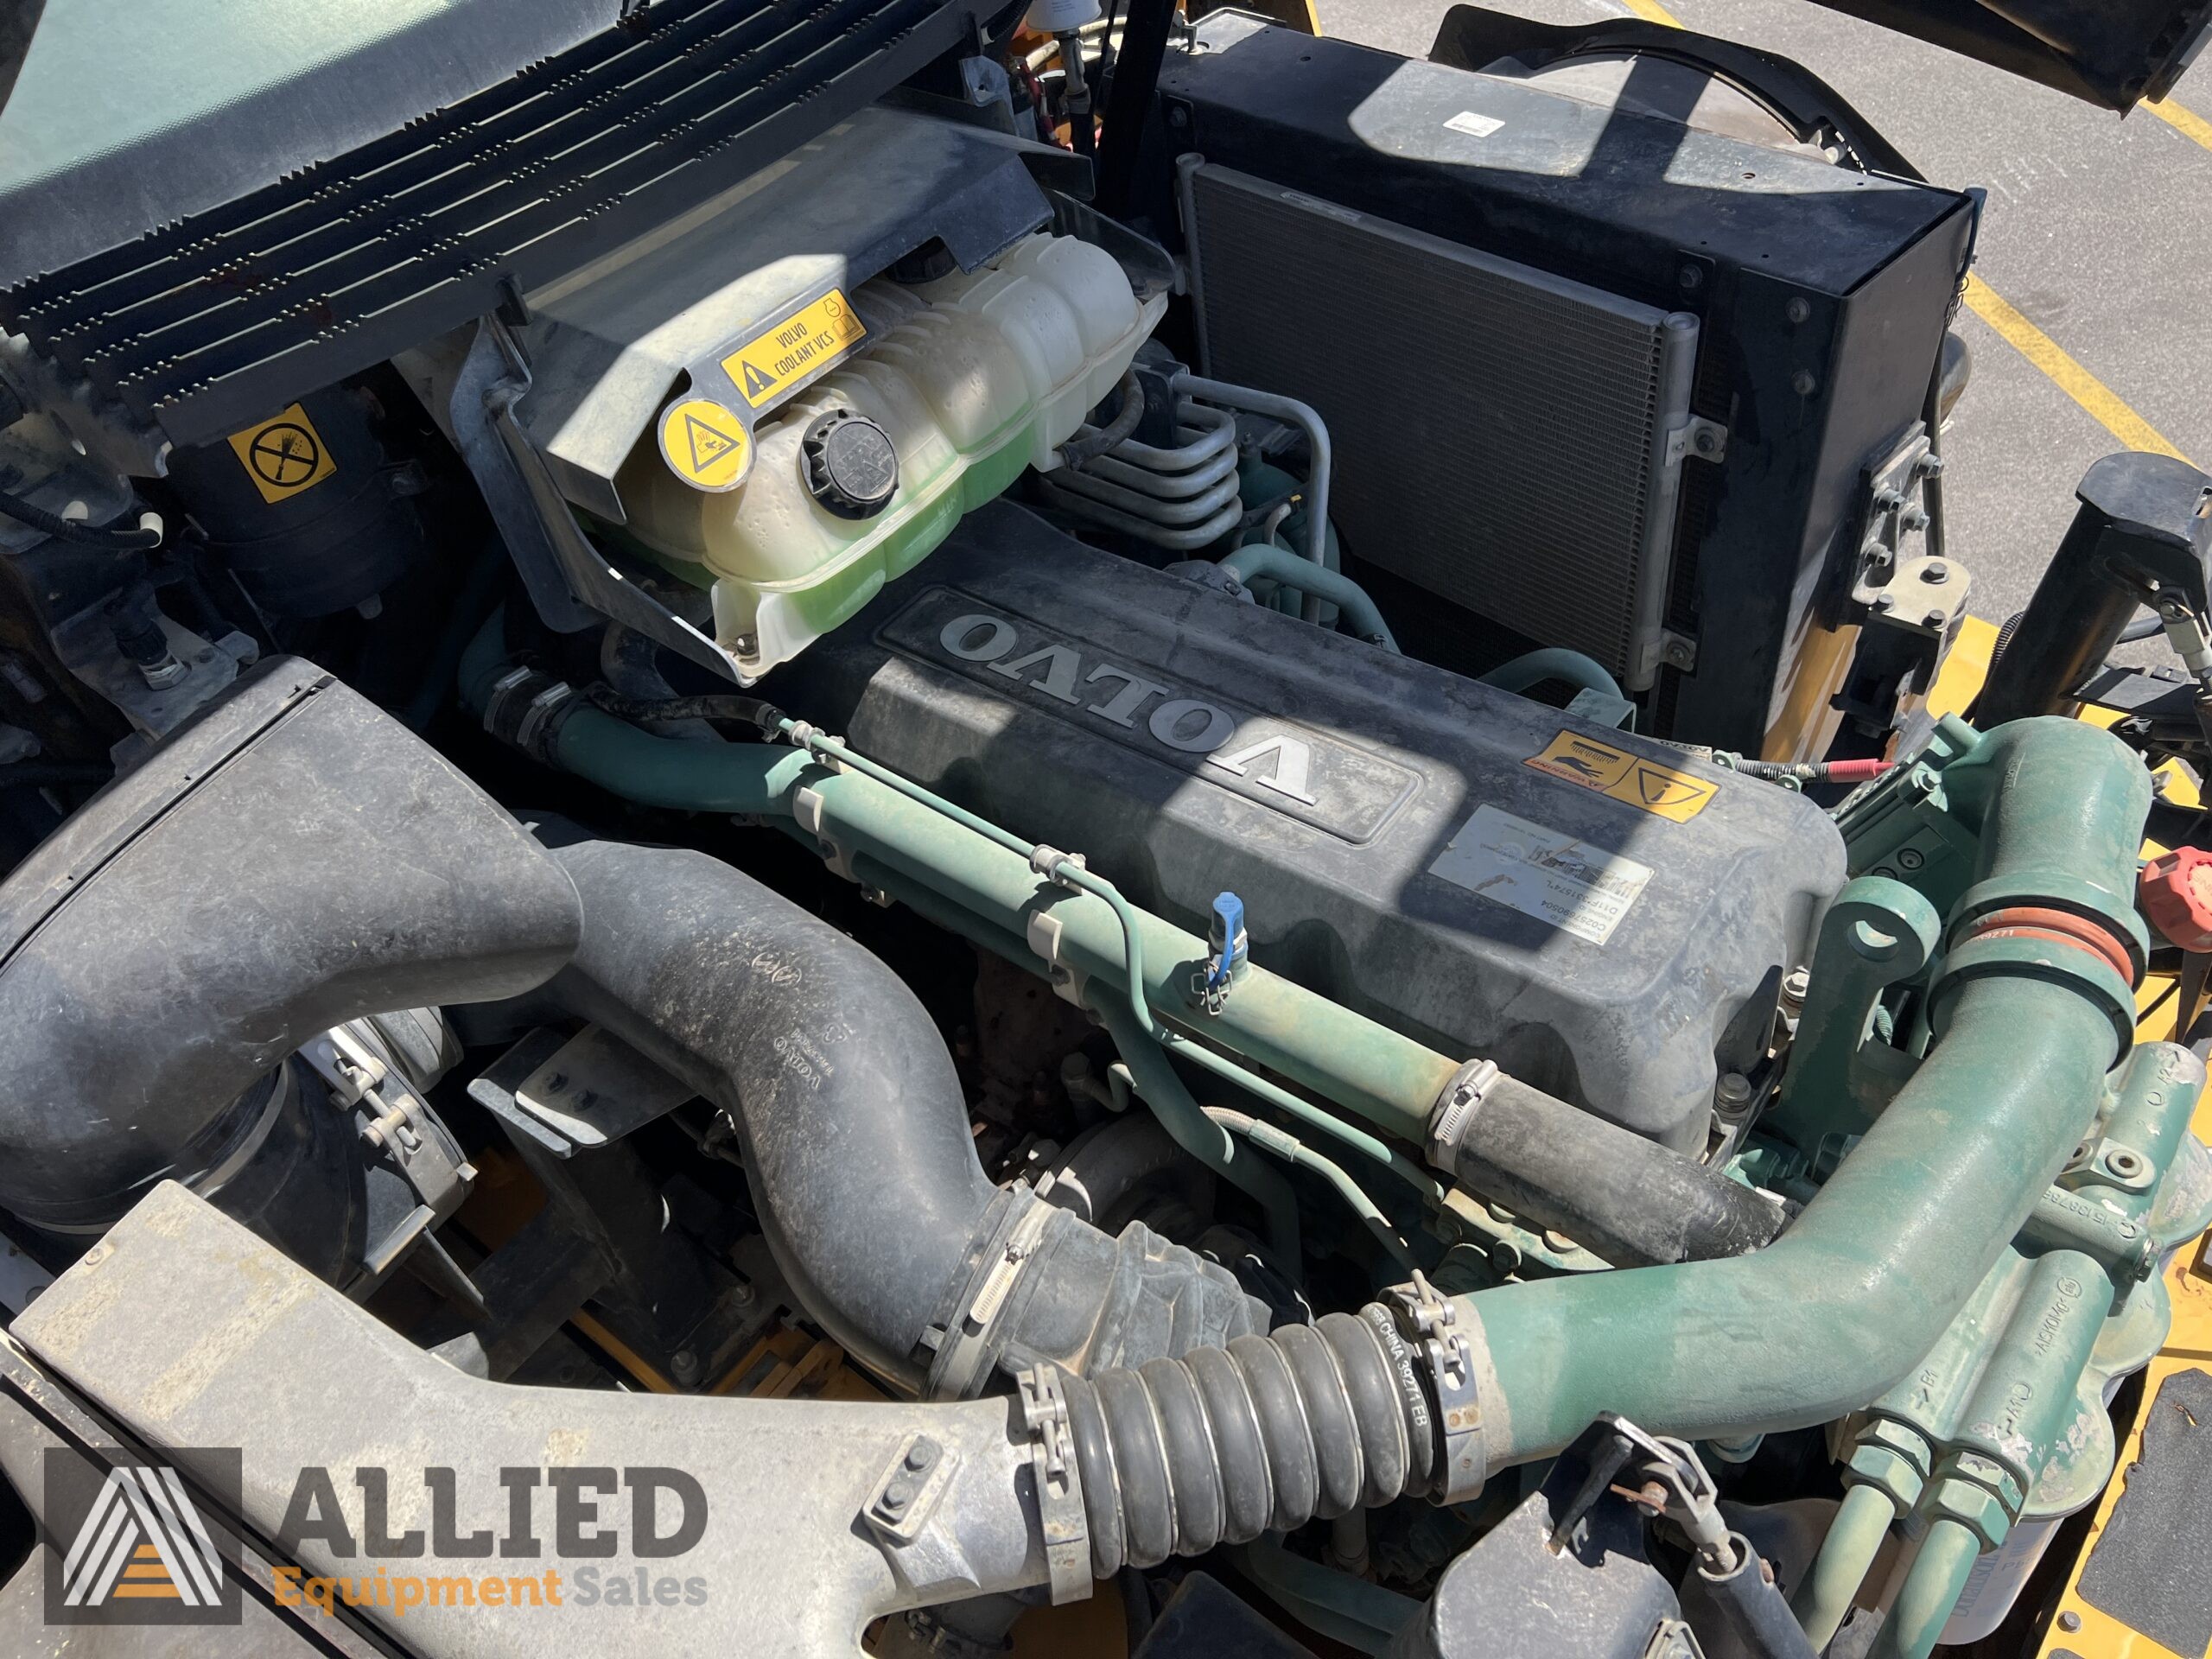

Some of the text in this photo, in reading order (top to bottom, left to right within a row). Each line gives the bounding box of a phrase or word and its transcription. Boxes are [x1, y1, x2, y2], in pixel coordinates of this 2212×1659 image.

[774, 330, 835, 377] COOLANT VCS
[776, 322, 808, 348] VOLVO
[939, 613, 1319, 806] VOLVO
[1530, 759, 1586, 783] WARNING
[1541, 899, 1606, 931] C0257690504
[774, 1037, 821, 1090] VOLVO
[1379, 1324, 1405, 1361] CHINA
[1397, 1360, 1421, 1403] 39271
[1411, 1406, 1427, 1427] EB
